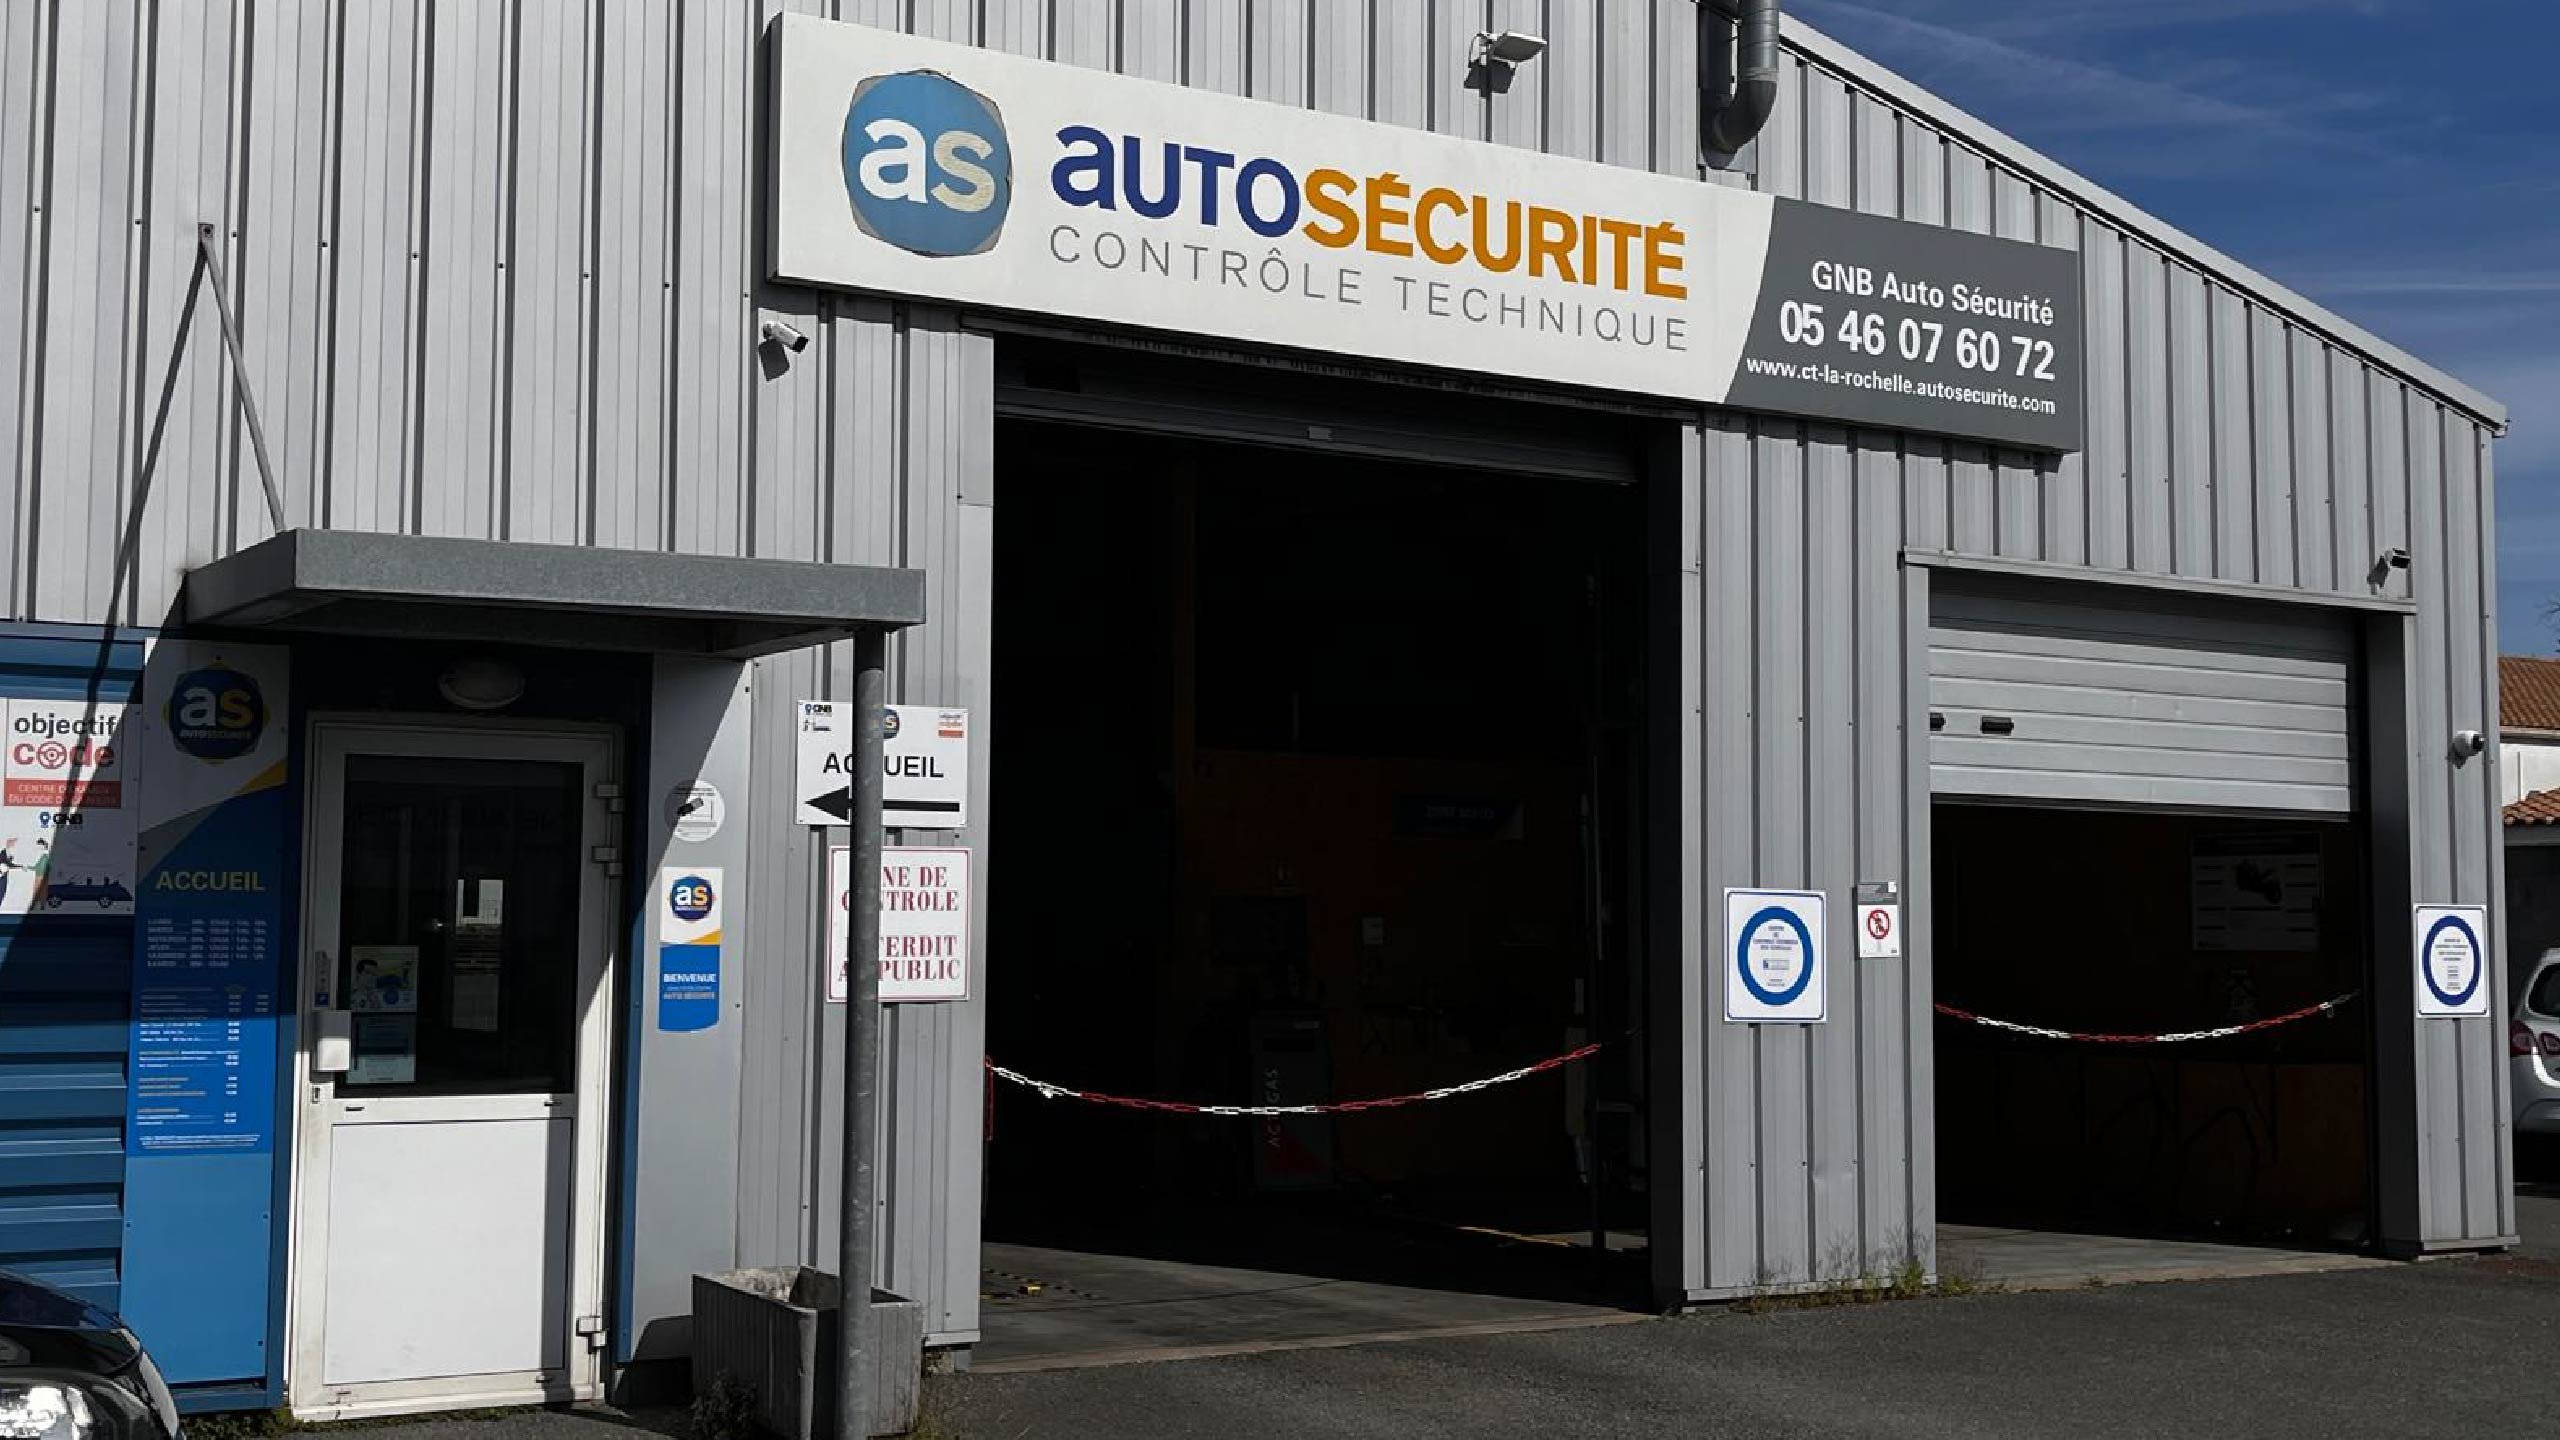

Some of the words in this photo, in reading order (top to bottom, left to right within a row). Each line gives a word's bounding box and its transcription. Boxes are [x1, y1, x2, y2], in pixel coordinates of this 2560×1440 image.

[858, 118, 996, 213] as
[1049, 225, 1362, 306] CONTRÔLE
[1394, 276, 1688, 352] TECHNIQUE
[1811, 260, 1874, 297] GNB
[1881, 271, 1944, 308] Auto
[1951, 283, 2055, 327] Sécurité
[1780, 300, 1825, 346] 05
[1838, 309, 1885, 356] 46
[1899, 318, 1943, 363] 07
[1956, 327, 2000, 372] 60
[2011, 335, 2056, 381] 72
[1746, 357, 2056, 415] www.ct-la-rochelle.autosecurite.com
[14, 712, 117, 739] objectif
[180, 686, 253, 728] as
[155, 871, 267, 891] ACCUEIL
[675, 886, 708, 906] as
[919, 866, 947, 887] DE
[877, 959, 960, 981] PUBLIC
